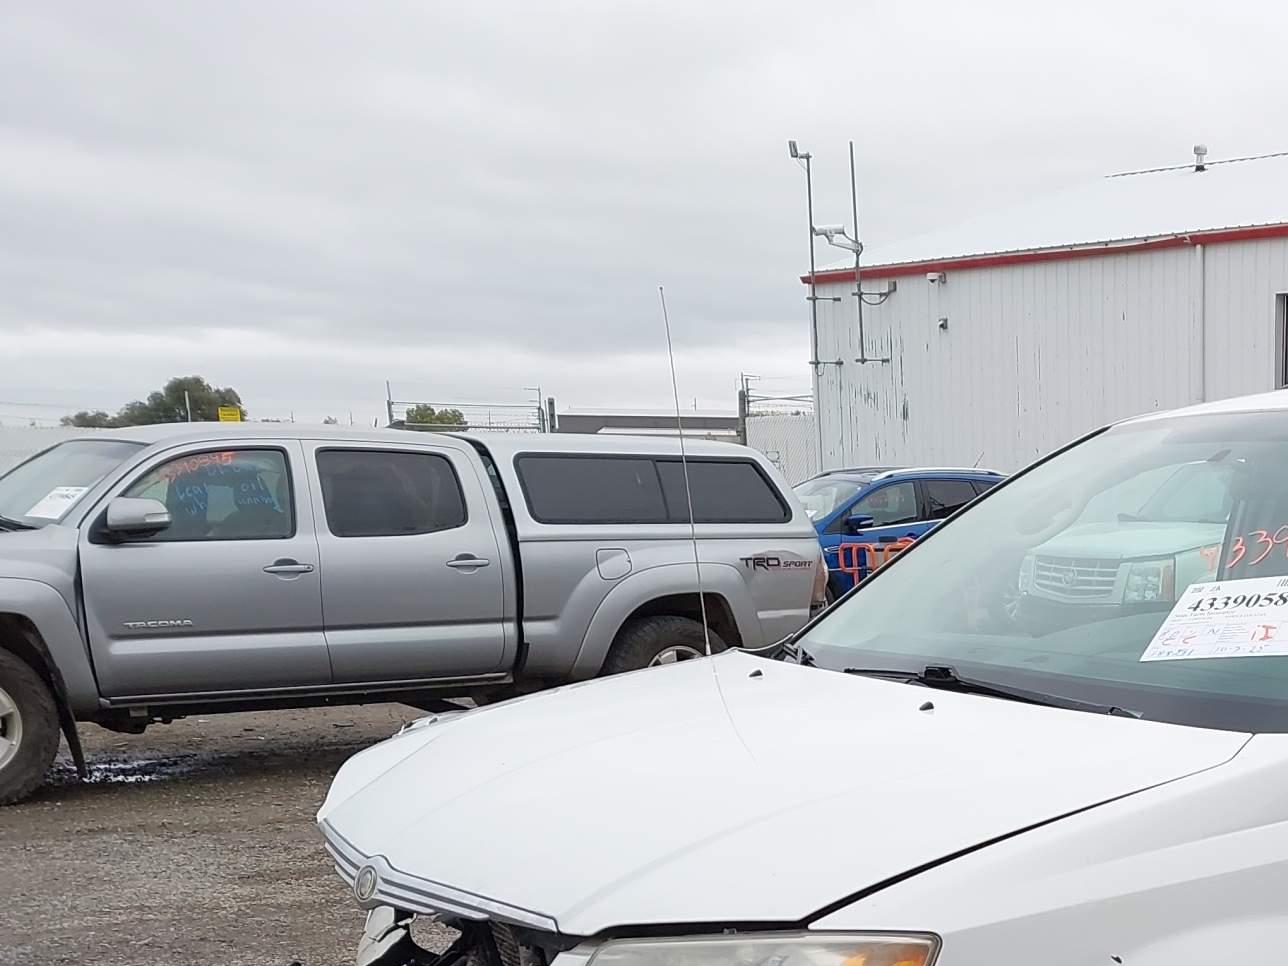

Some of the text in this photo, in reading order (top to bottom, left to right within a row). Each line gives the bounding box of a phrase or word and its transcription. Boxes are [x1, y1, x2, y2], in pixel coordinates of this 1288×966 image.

[739, 557, 813, 571] TRD SPORT
[123, 619, 193, 629] TACOMA
